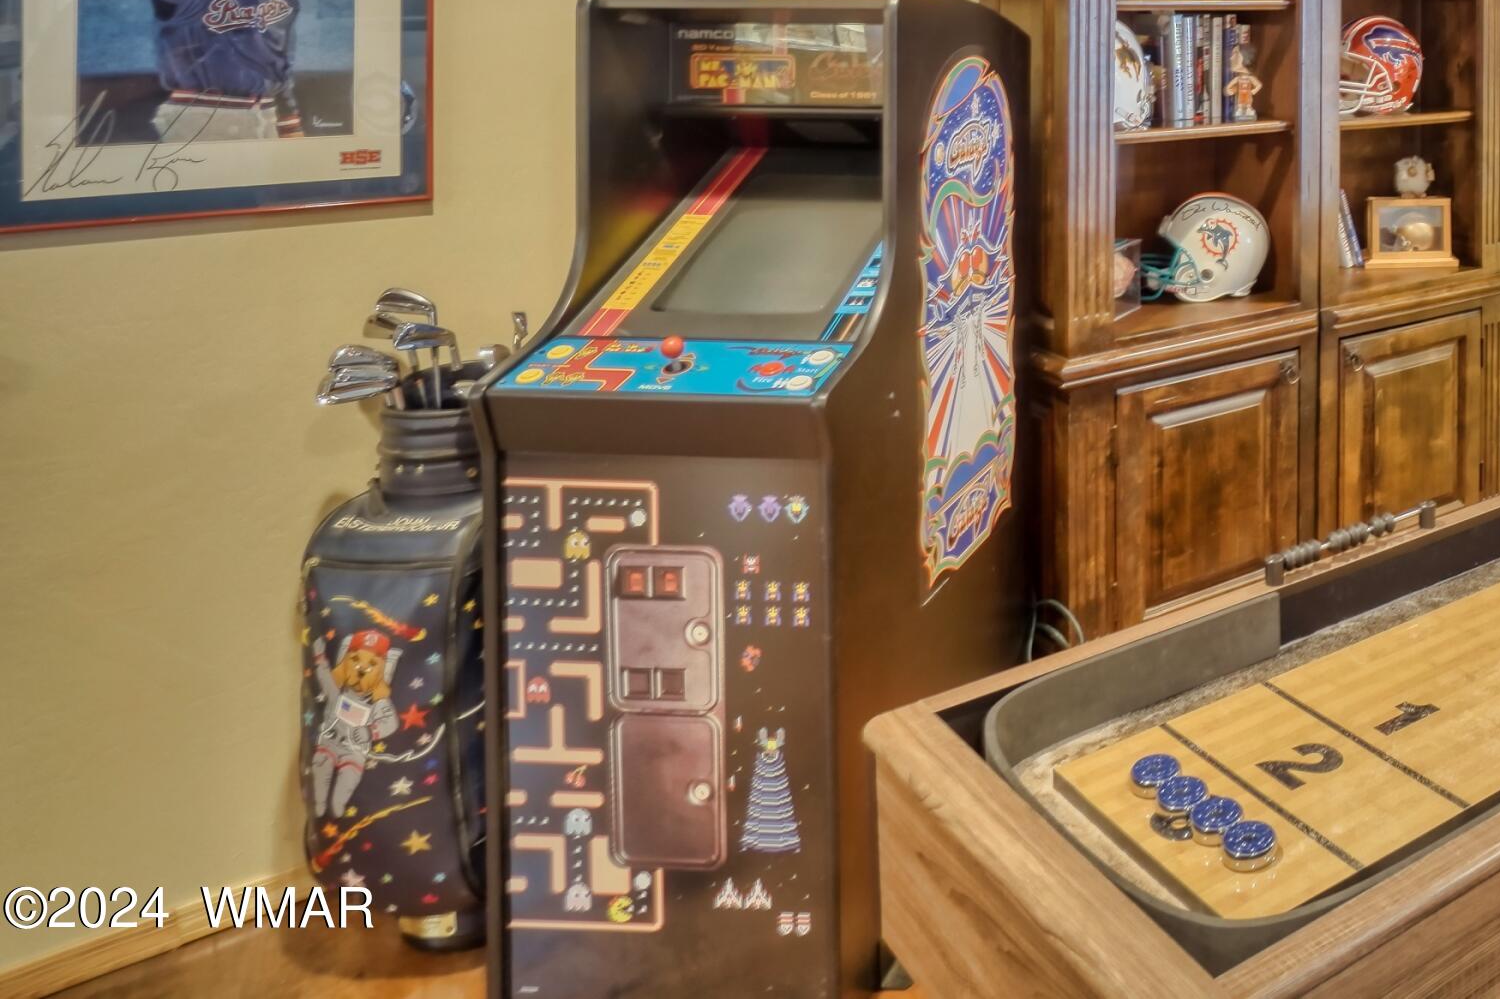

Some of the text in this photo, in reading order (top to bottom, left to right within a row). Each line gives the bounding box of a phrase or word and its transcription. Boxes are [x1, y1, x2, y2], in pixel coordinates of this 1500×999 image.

[677, 29, 735, 40] namco
[638, 383, 673, 391] MOVE
[1374, 701, 1441, 736] 1
[1256, 743, 1344, 790] 2
